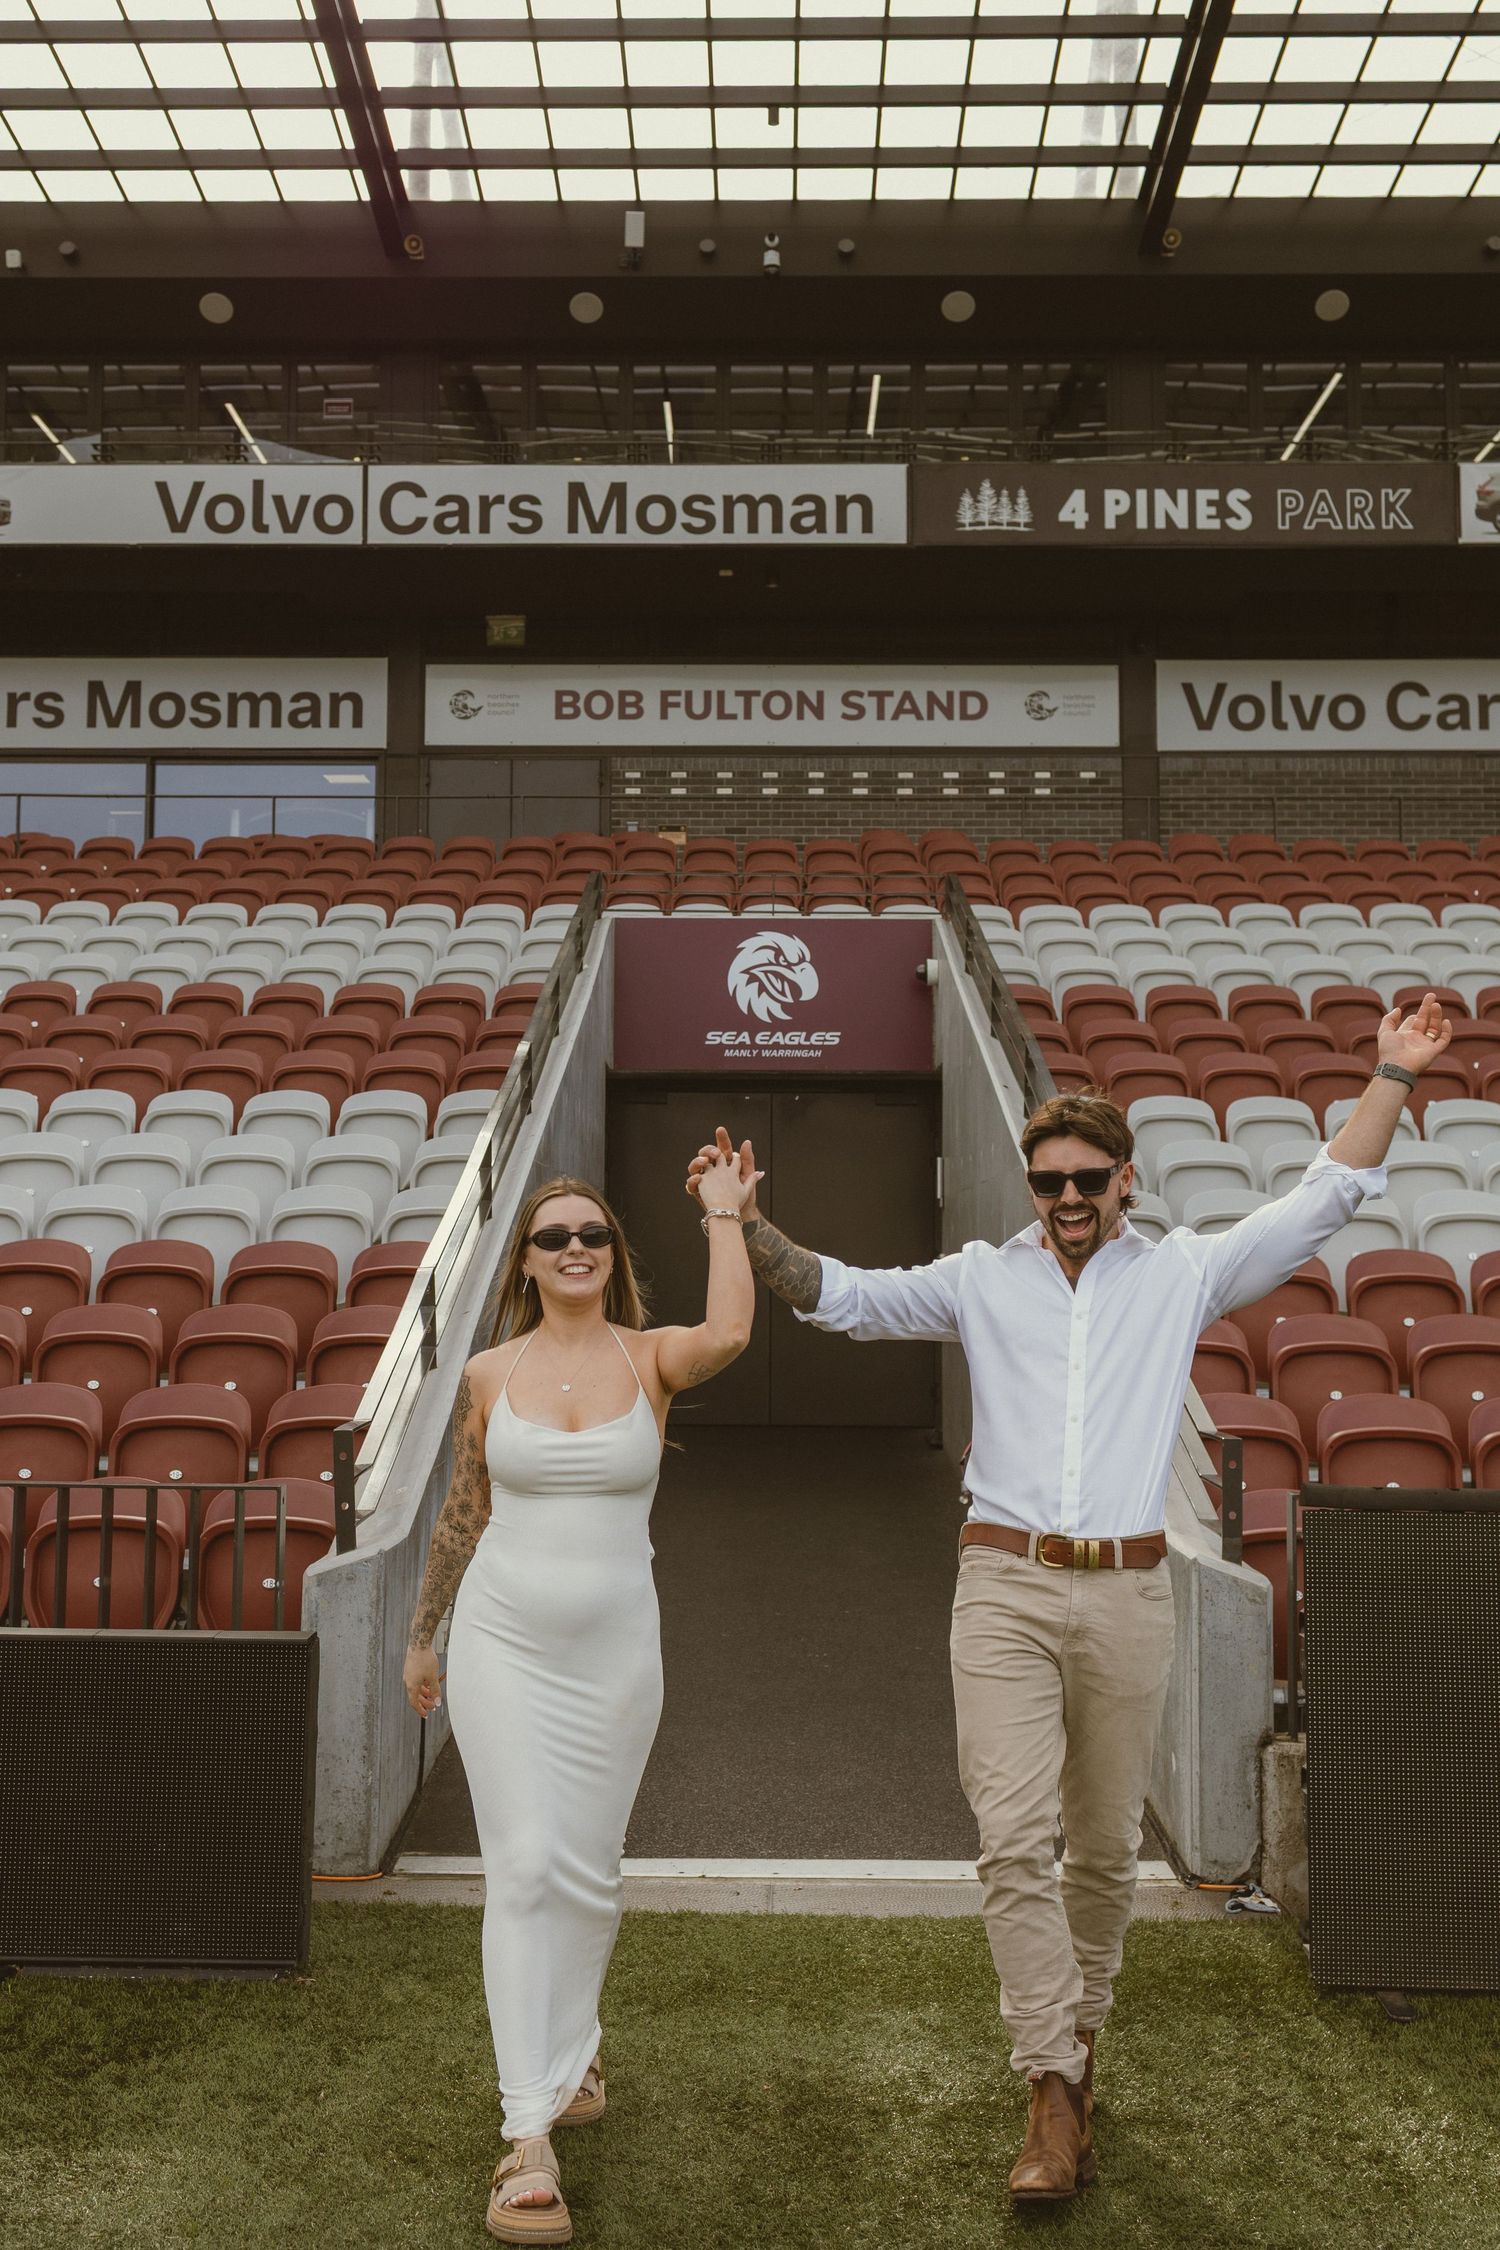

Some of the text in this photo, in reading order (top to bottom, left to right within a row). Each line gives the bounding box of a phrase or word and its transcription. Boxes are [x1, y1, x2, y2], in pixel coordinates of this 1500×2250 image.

[154, 478, 874, 535] Volvo Cars Mosman
[1057, 487, 1414, 531] 4 PINES PARK
[6, 679, 364, 730] rs Mosman
[554, 689, 989, 722] BOB FULTON STAND
[1180, 679, 1500, 732] Volvo Car
[704, 1031, 842, 1046] SEA EAGLES
[724, 1048, 823, 1058] MANLY WARRINGAH
